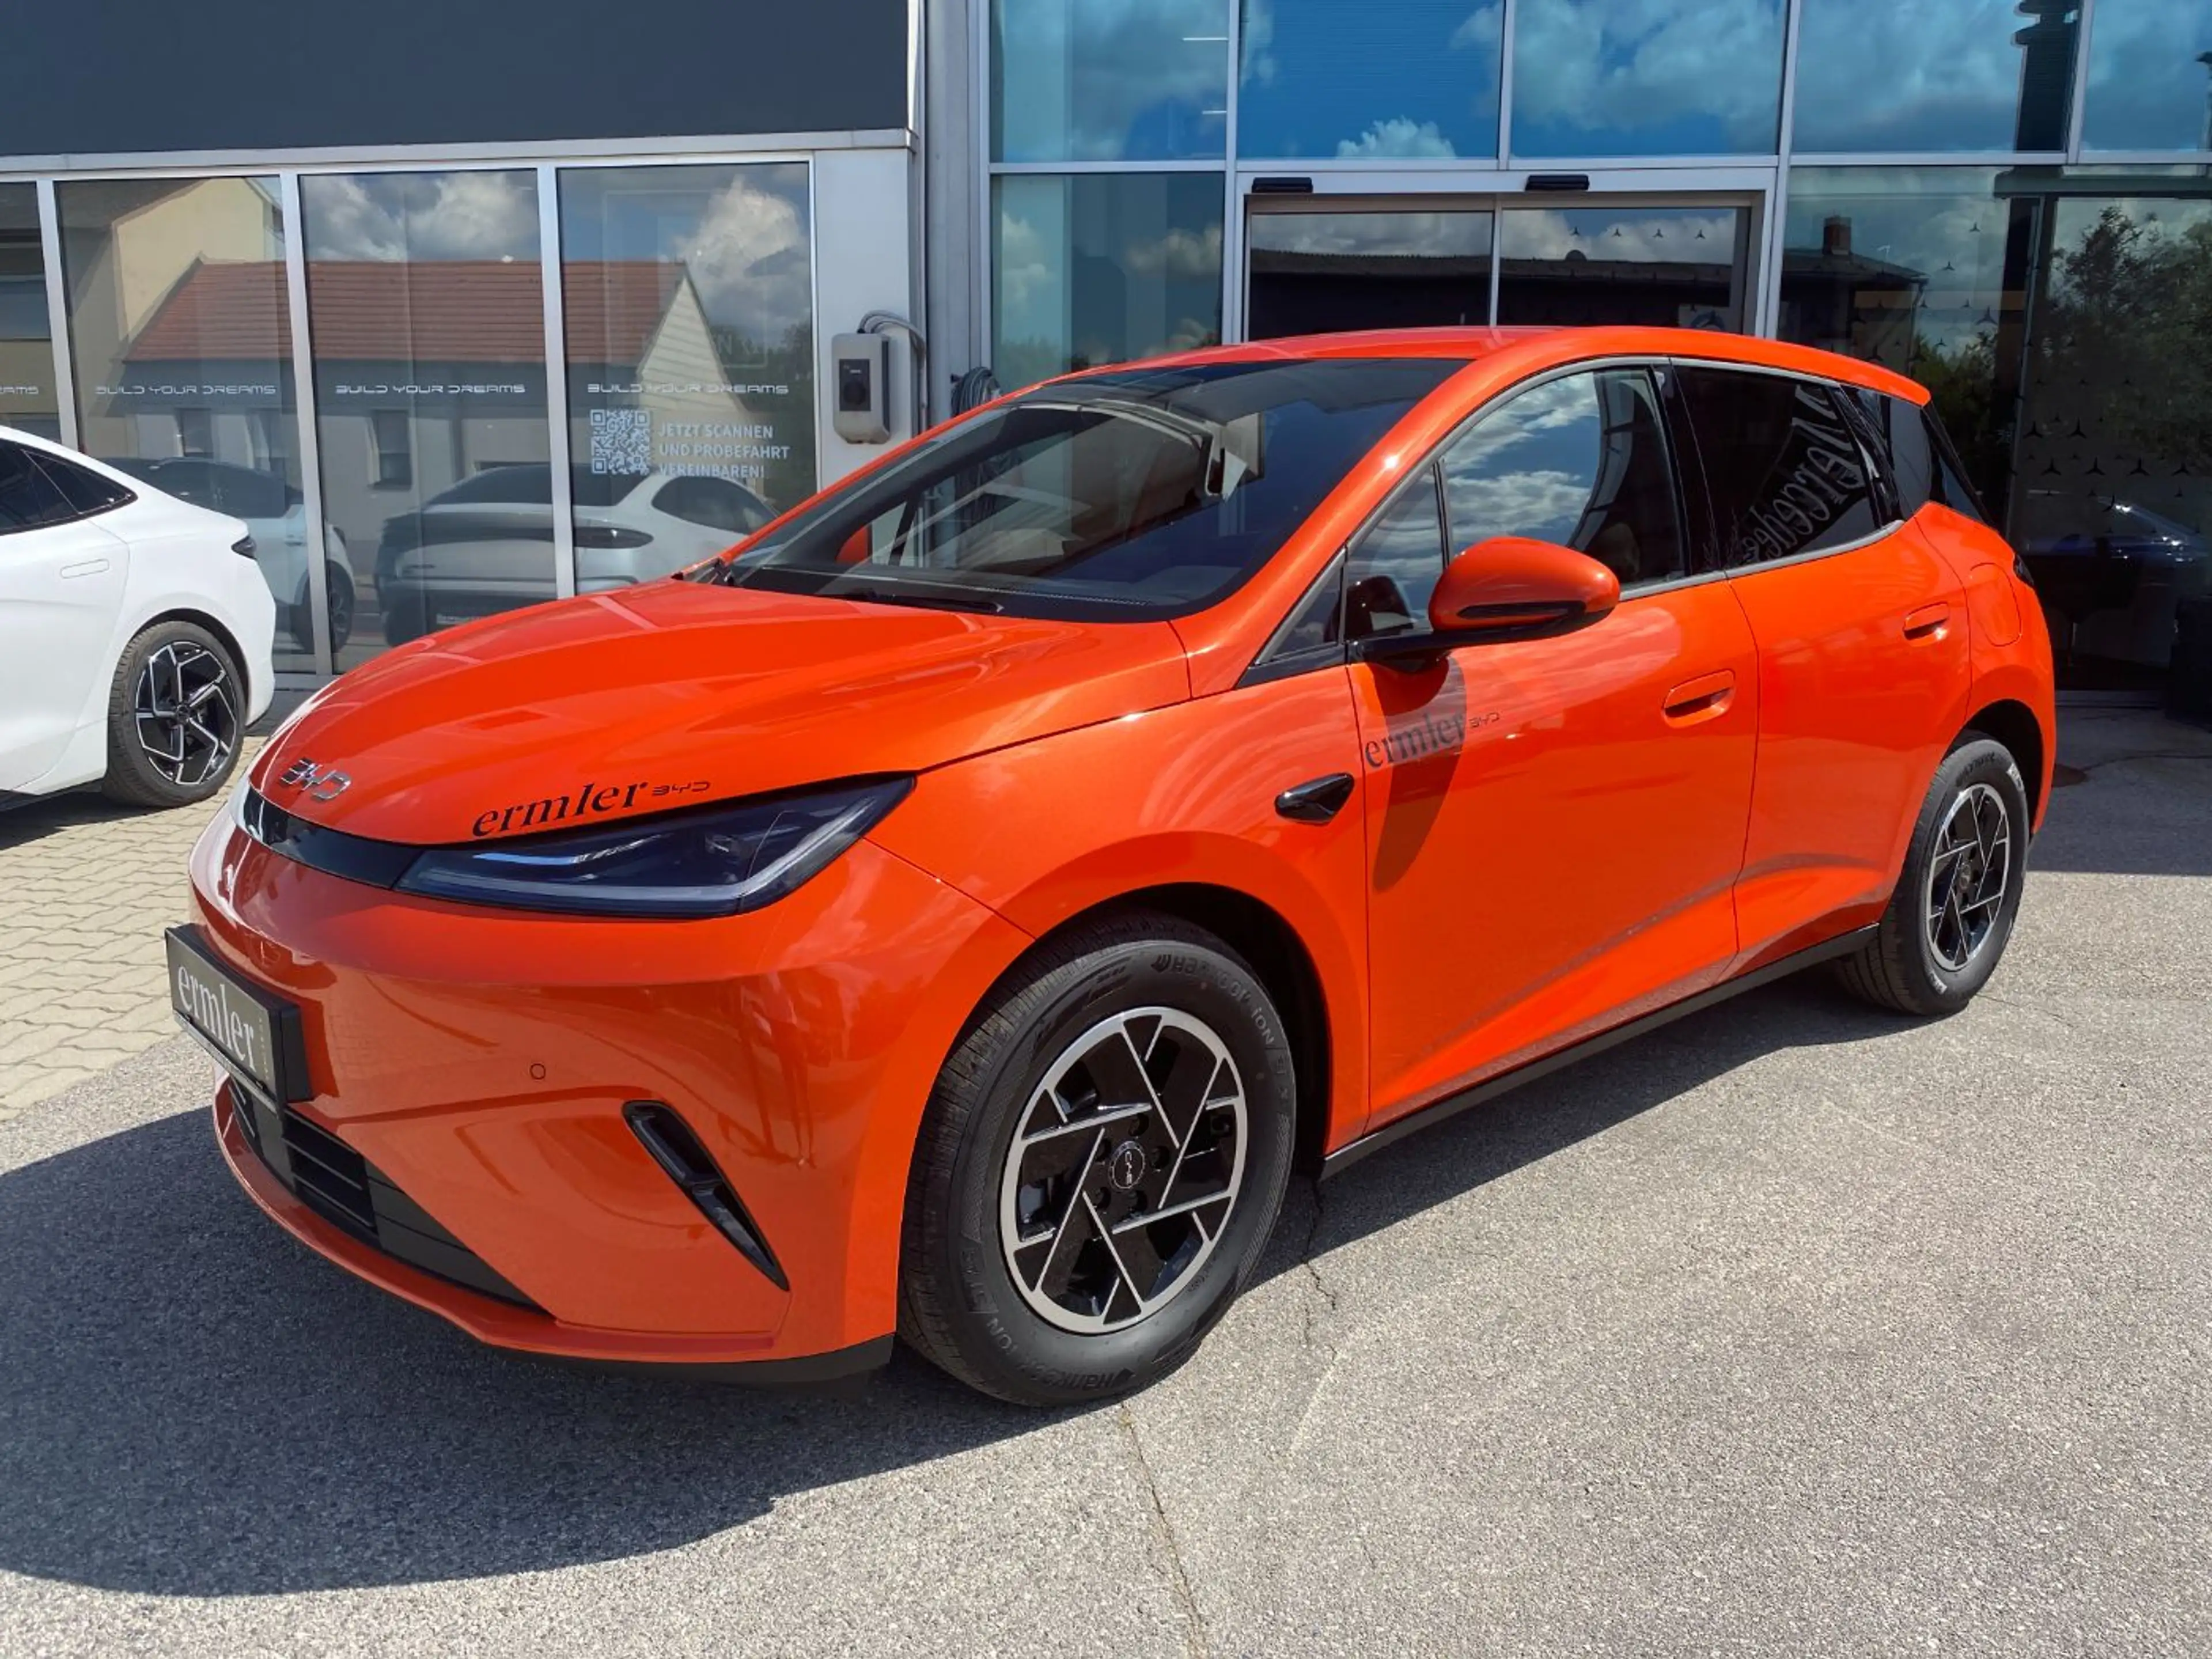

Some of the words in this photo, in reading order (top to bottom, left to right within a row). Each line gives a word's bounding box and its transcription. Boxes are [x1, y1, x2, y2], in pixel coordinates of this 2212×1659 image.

[95, 385, 145, 395] BUILD
[147, 385, 198, 395] YOUR
[202, 384, 276, 395] DREAMS
[335, 385, 388, 394] BUILD
[392, 385, 444, 394] YOUR
[447, 384, 526, 394] DREAMS
[588, 384, 642, 393] BUILD
[647, 384, 700, 393] YOUR
[707, 384, 789, 394] DREAMS
[659, 423, 699, 438] JETZT
[704, 424, 774, 440] SCANNEN
[659, 444, 690, 457] UND
[693, 444, 791, 460] PROBEFAHRT
[659, 464, 765, 479] VEREINBAREN!
[1365, 712, 1465, 768] ermler
[472, 782, 649, 837] ermler
[651, 781, 710, 797] BYD
[179, 966, 257, 1073] ermler
